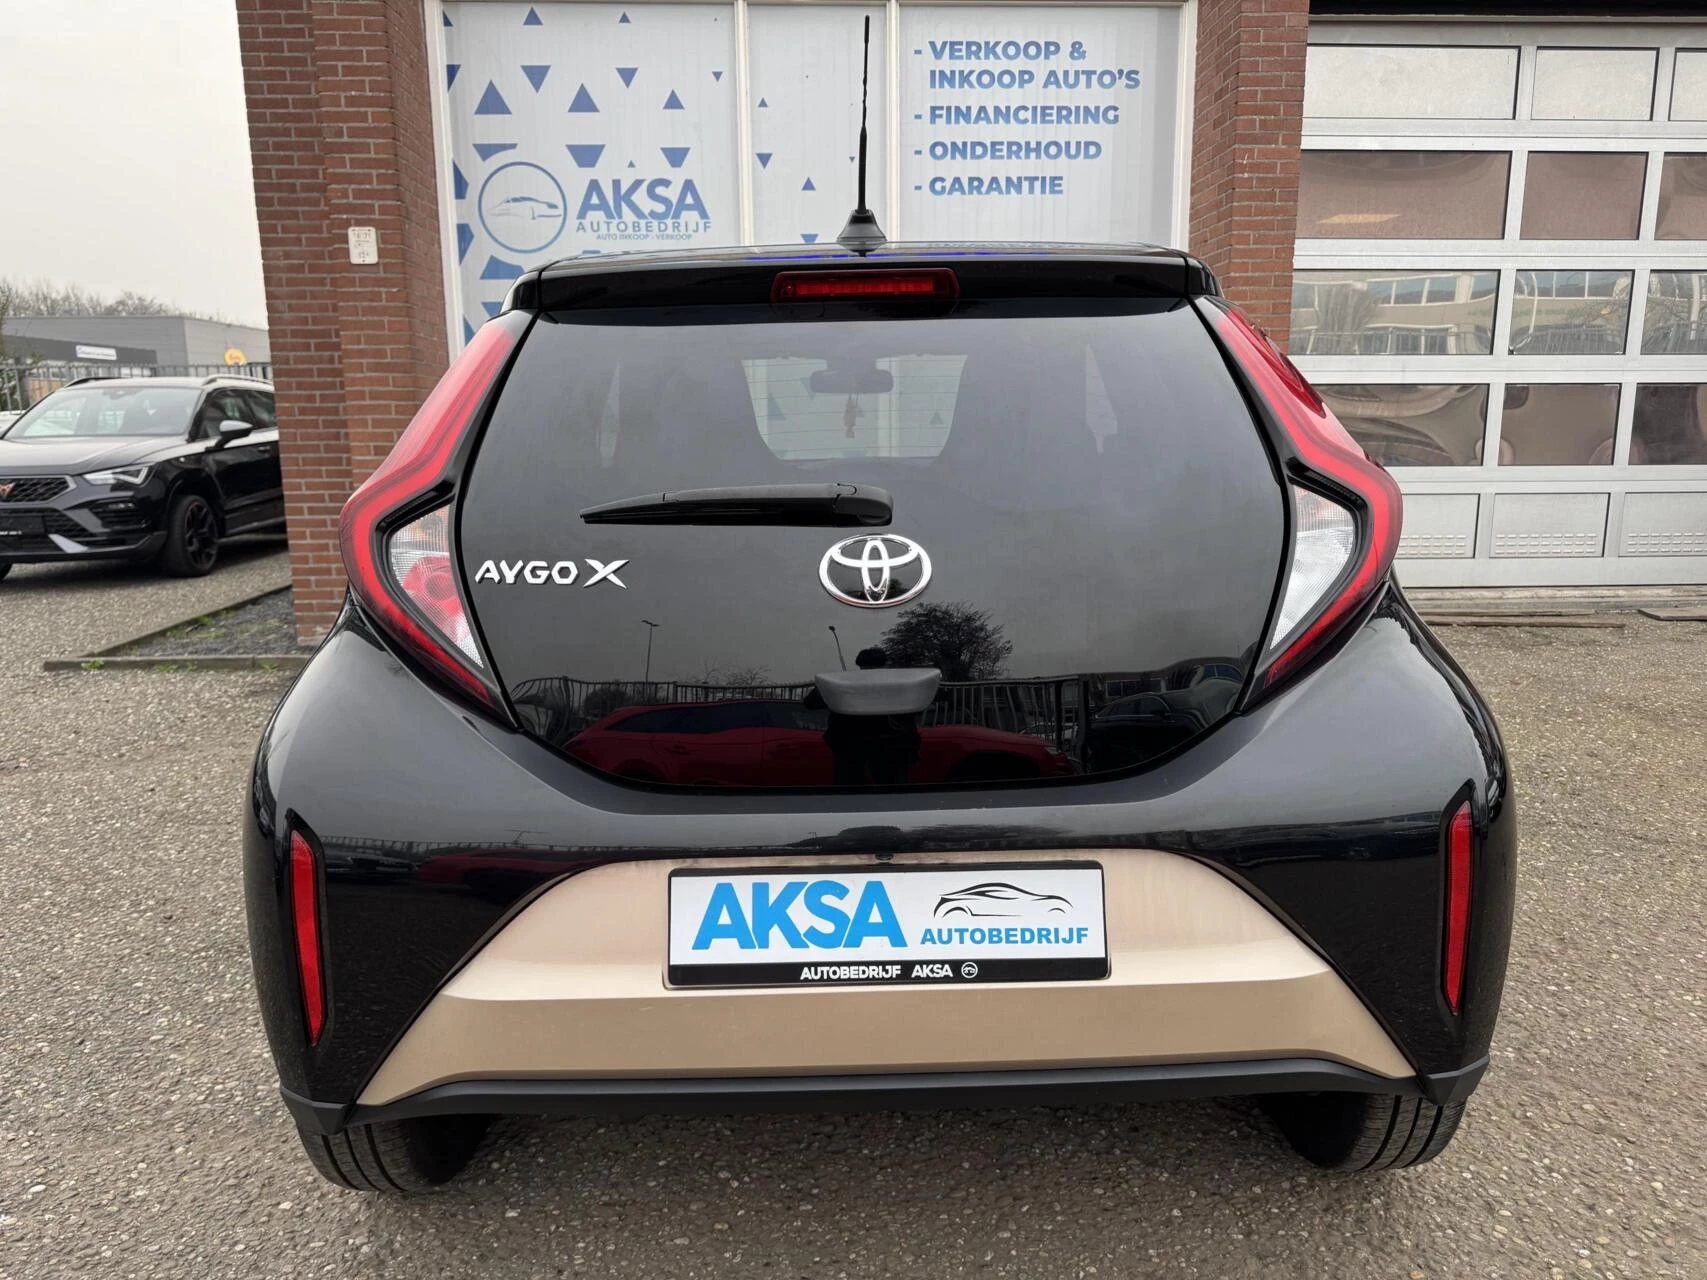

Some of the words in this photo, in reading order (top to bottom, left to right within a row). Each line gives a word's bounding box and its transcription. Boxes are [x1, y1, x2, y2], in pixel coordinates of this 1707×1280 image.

[928, 40, 1061, 61] VERKOOP
[1069, 40, 1087, 61] &
[929, 69, 1035, 89] INKOOP
[1042, 68, 1141, 89] AUTO'S
[929, 105, 1120, 125] FINANCIERING
[929, 140, 1102, 160] ONDERHOUD
[929, 175, 1064, 196] GARANTIE
[576, 178, 710, 221] AKSA
[576, 221, 711, 233] AUTOBEDRIJF
[596, 233, 618, 241] AUTO
[619, 233, 650, 241] INKOOP
[656, 233, 693, 241] VERKOOP
[475, 559, 579, 584] AYGO
[583, 558, 630, 589] X
[692, 880, 907, 950] AKSA
[920, 927, 1089, 945] AUTOBEDRIJF
[800, 965, 901, 981] AUTOBEDRIJF
[911, 964, 953, 979] AKSA
